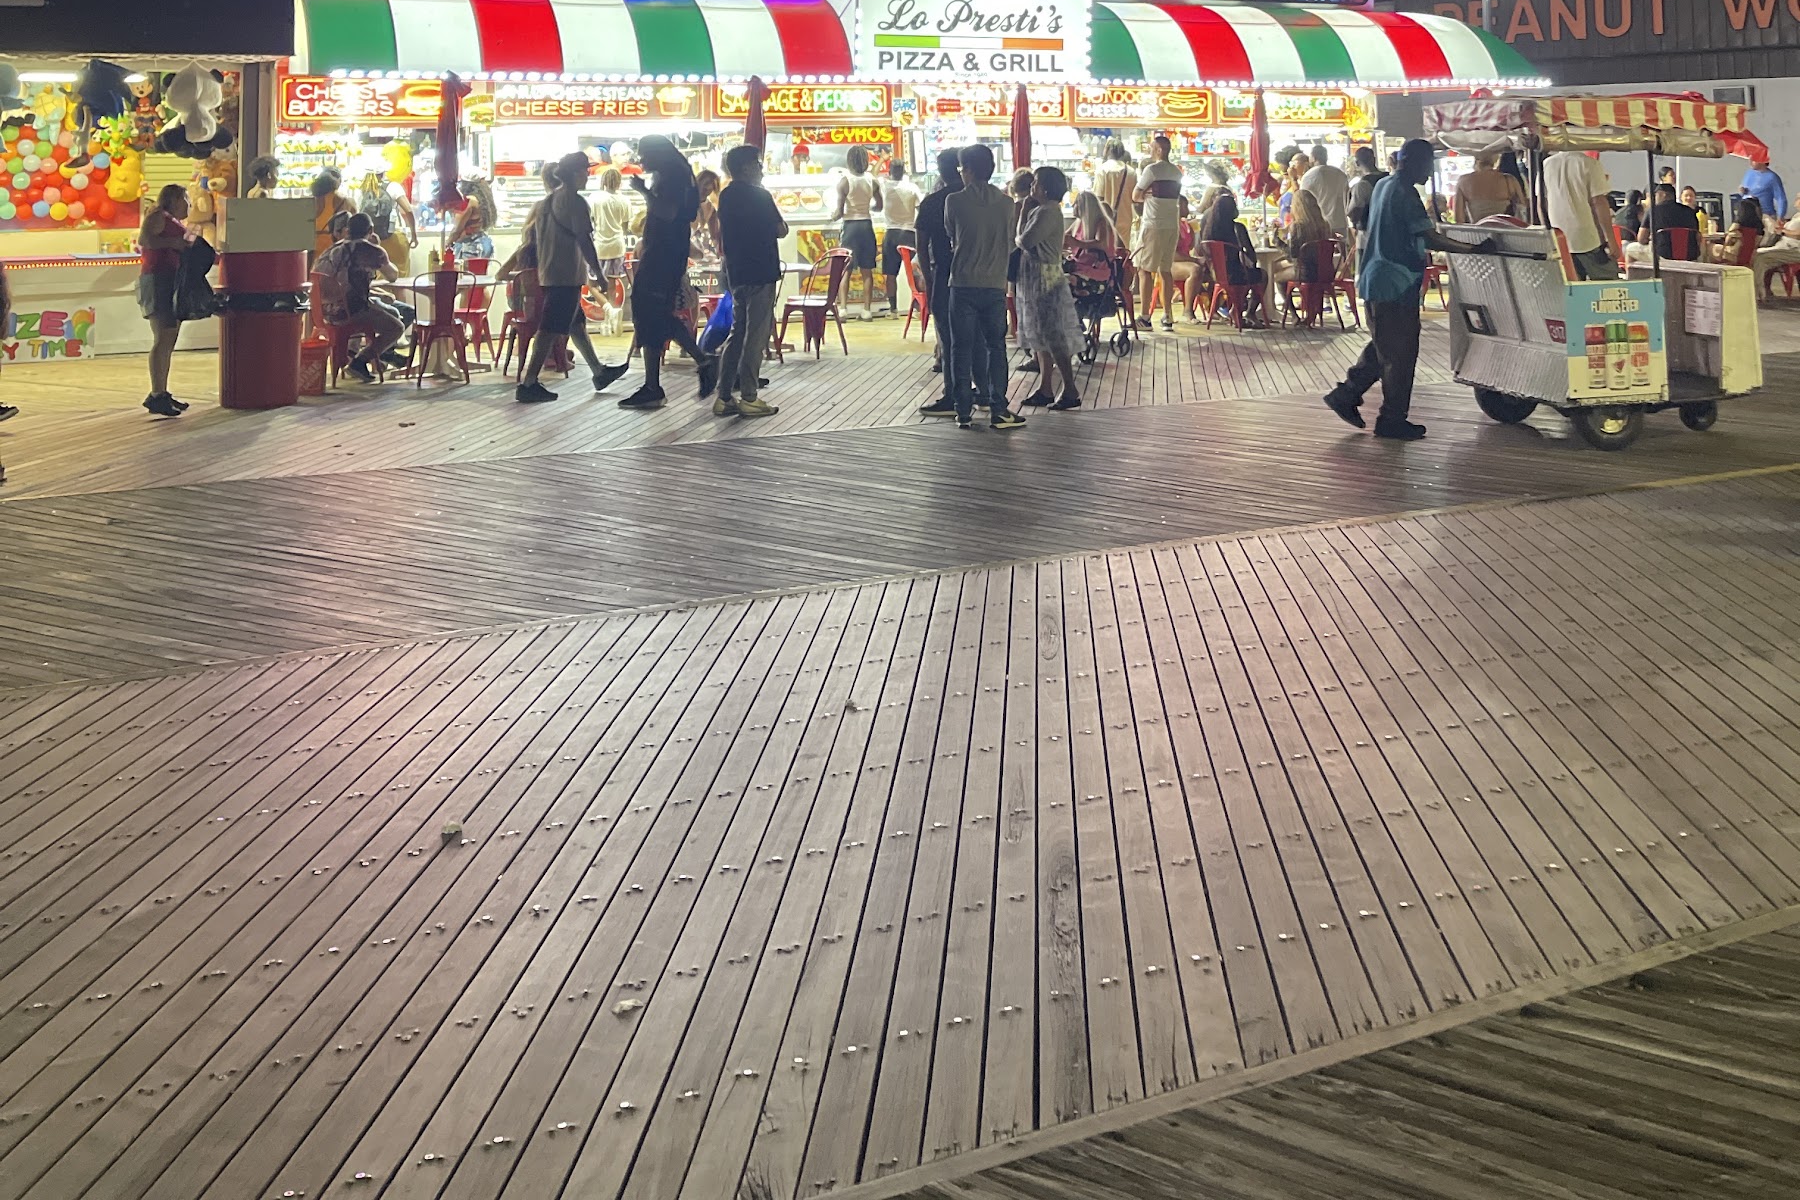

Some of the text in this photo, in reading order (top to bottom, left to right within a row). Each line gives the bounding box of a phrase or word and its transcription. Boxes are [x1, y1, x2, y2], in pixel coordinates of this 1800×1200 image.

[936, 0, 1064, 34] Presti's
[878, 50, 1064, 73] PIZZA & GRILL
[295, 84, 389, 100] CHESE
[800, 88, 812, 112] &
[287, 99, 395, 116] BURGERS
[500, 101, 649, 116] CHEESE FRIES
[831, 127, 894, 143] GYROS
[27, 339, 84, 359] TIME
